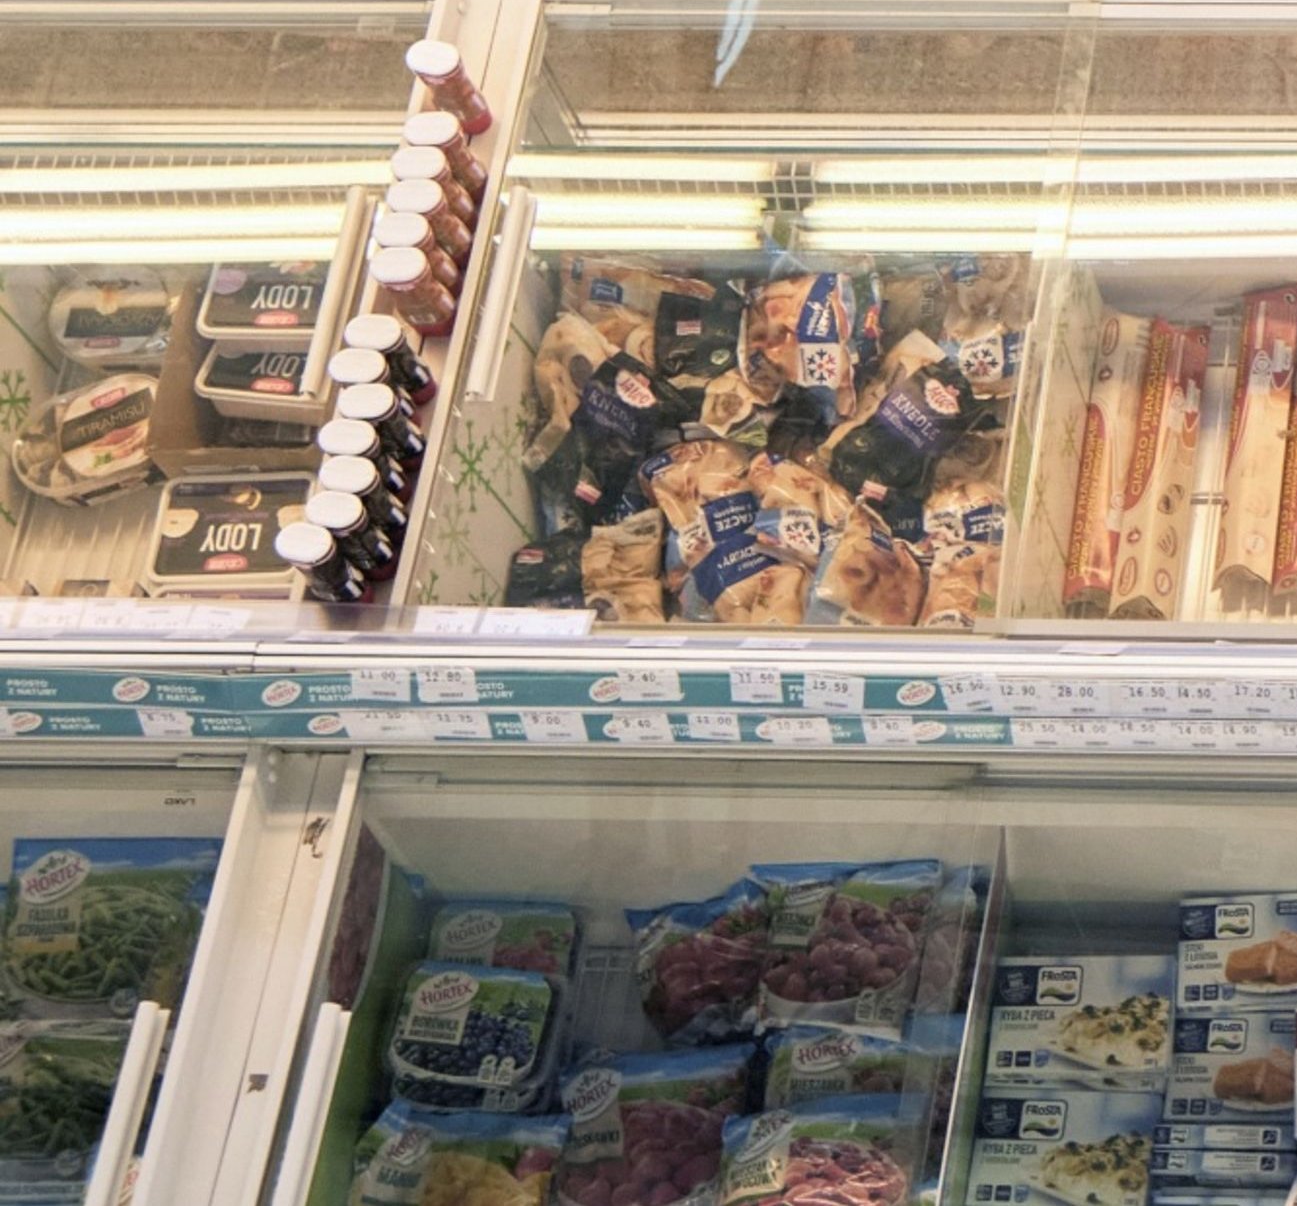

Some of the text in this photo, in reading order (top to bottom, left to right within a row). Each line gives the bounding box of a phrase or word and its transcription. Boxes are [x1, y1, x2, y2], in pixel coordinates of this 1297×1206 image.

[251, 285, 313, 309] LODY
[76, 403, 147, 437] TIRAMISU
[889, 393, 941, 441] KNEDLE
[1131, 333, 1170, 496] CIASTO FRANCUSKIE
[200, 523, 262, 551] LODY
[360, 671, 395, 680] 11.00
[7, 679, 49, 688] PROSTO
[156, 685, 196, 693] PROSTO
[308, 685, 351, 693] PROSTO
[812, 681, 849, 693] 15.59
[1000, 685, 1035, 696] 12.90
[1057, 686, 1094, 698] 28.00
[1129, 687, 1166, 698] 16.50
[1234, 685, 1271, 698] 17.20
[50, 716, 91, 724] PROSTO
[202, 716, 242, 725] PROSTO
[1178, 725, 1214, 735] 14.00
[24, 860, 85, 896] HORTEX
[444, 915, 499, 943] HORTEX
[419, 982, 473, 1008] HORTEX
[798, 1037, 856, 1065] HORTEX
[566, 1076, 617, 1110] HORTEX
